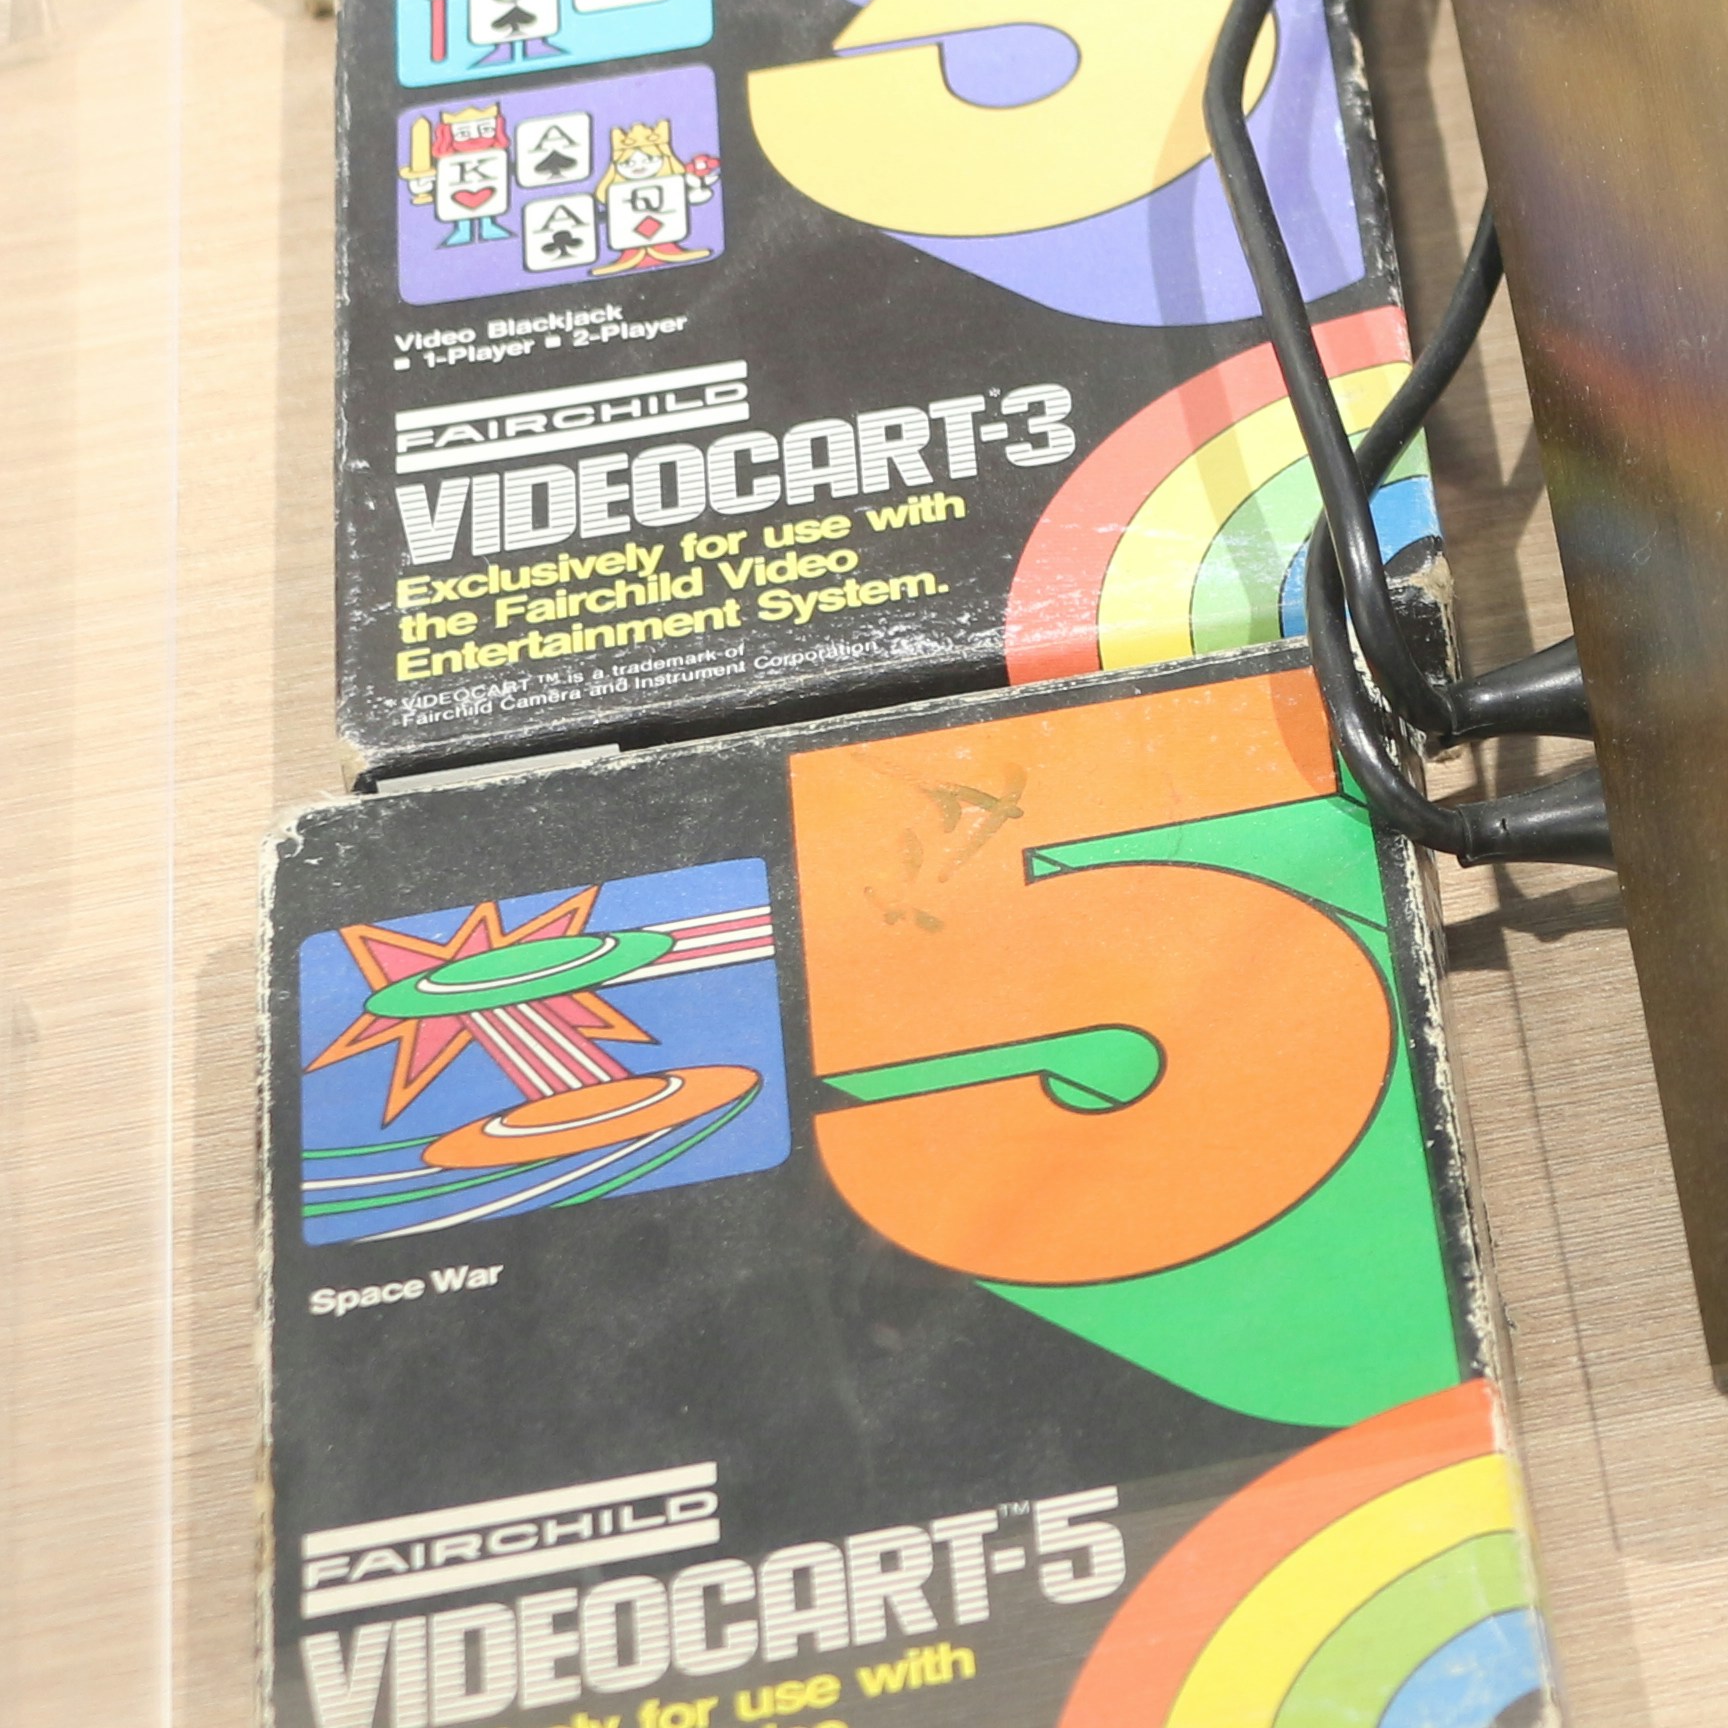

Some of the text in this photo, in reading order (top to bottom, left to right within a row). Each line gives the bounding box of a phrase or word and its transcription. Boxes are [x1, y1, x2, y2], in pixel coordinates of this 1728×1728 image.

[394, 304, 623, 352] Video Blackjack
[424, 315, 688, 368] 1-Player 2-Player
[397, 382, 748, 453] FAIRCHILD
[395, 383, 1076, 565] VIDEOCART-3
[396, 491, 967, 609] Exclusively for use with
[399, 548, 859, 644] the Fairchild Video
[396, 572, 949, 682] Entertainment System.
[401, 676, 531, 712] VIDEOCART
[567, 667, 585, 685] is
[590, 667, 605, 680] a
[611, 647, 717, 677] trademark
[724, 641, 746, 659] of
[402, 640, 878, 728] Fairchild Camera and Instrument Corporation
[788, 662, 1392, 1286] 5
[308, 1264, 504, 1317] Space War
[305, 1491, 718, 1590] FAIRCHILD
[300, 1485, 1126, 1728] VIDEOCART-5
[637, 1641, 976, 1728] for use with
